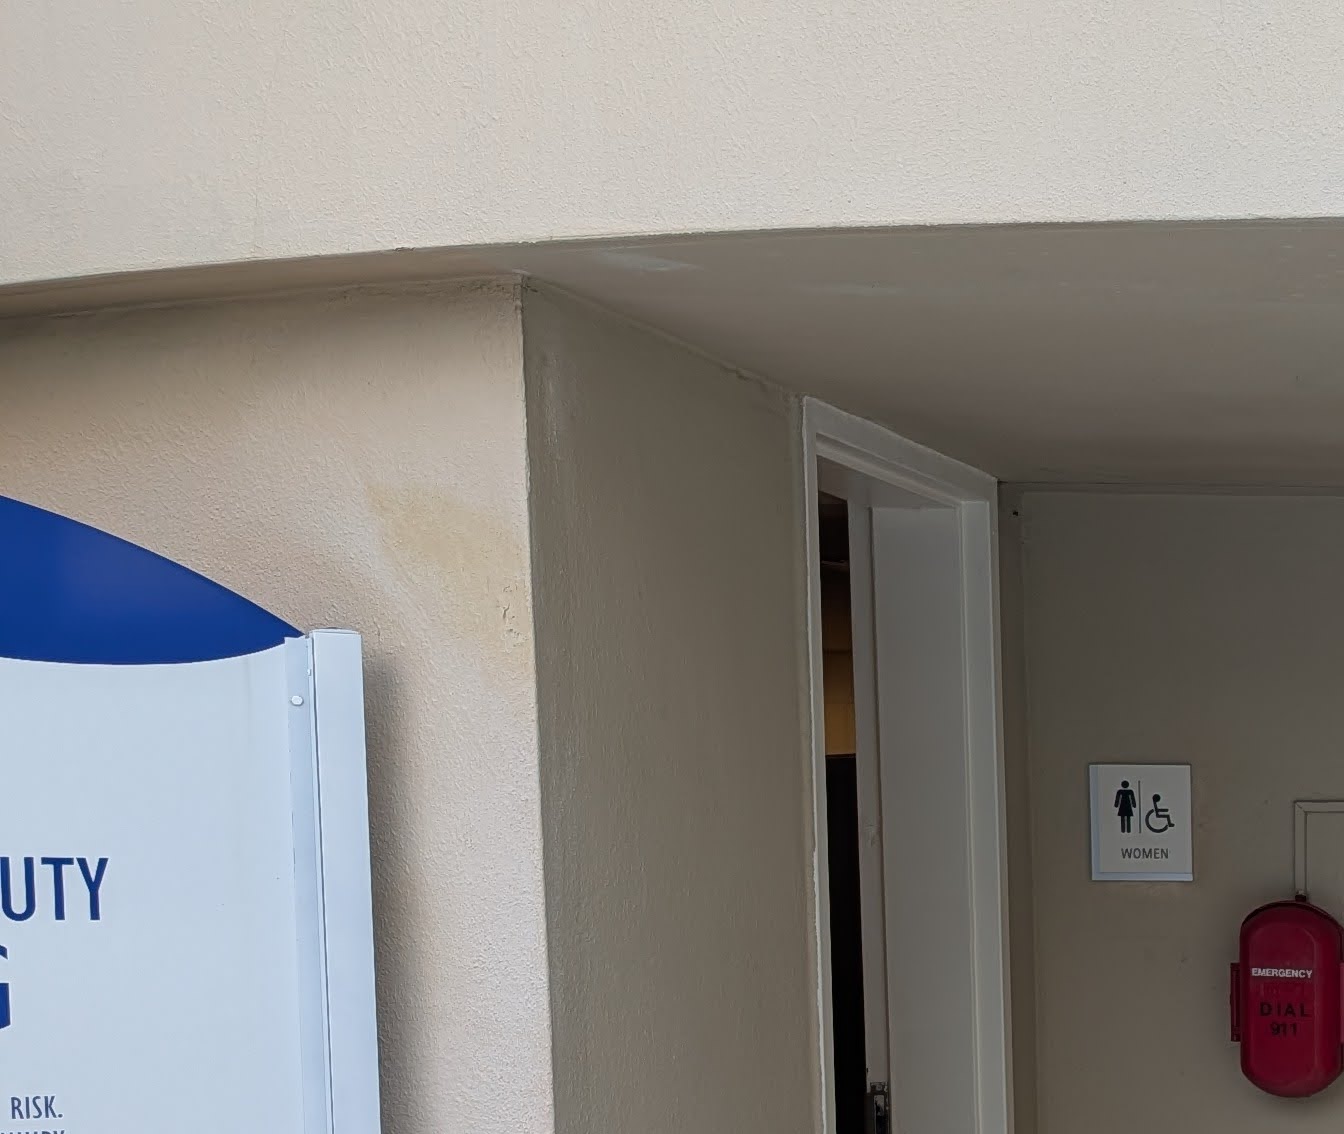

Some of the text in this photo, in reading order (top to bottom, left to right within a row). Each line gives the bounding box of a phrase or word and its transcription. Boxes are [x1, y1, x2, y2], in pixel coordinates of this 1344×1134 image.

[1121, 848, 1169, 859] WOMEN
[0, 857, 108, 921] UTY
[1251, 967, 1313, 979] EMERGENCY
[1259, 1001, 1312, 1017] DIAL
[1270, 1022, 1298, 1036] 911
[11, 1096, 62, 1119] RISK.
